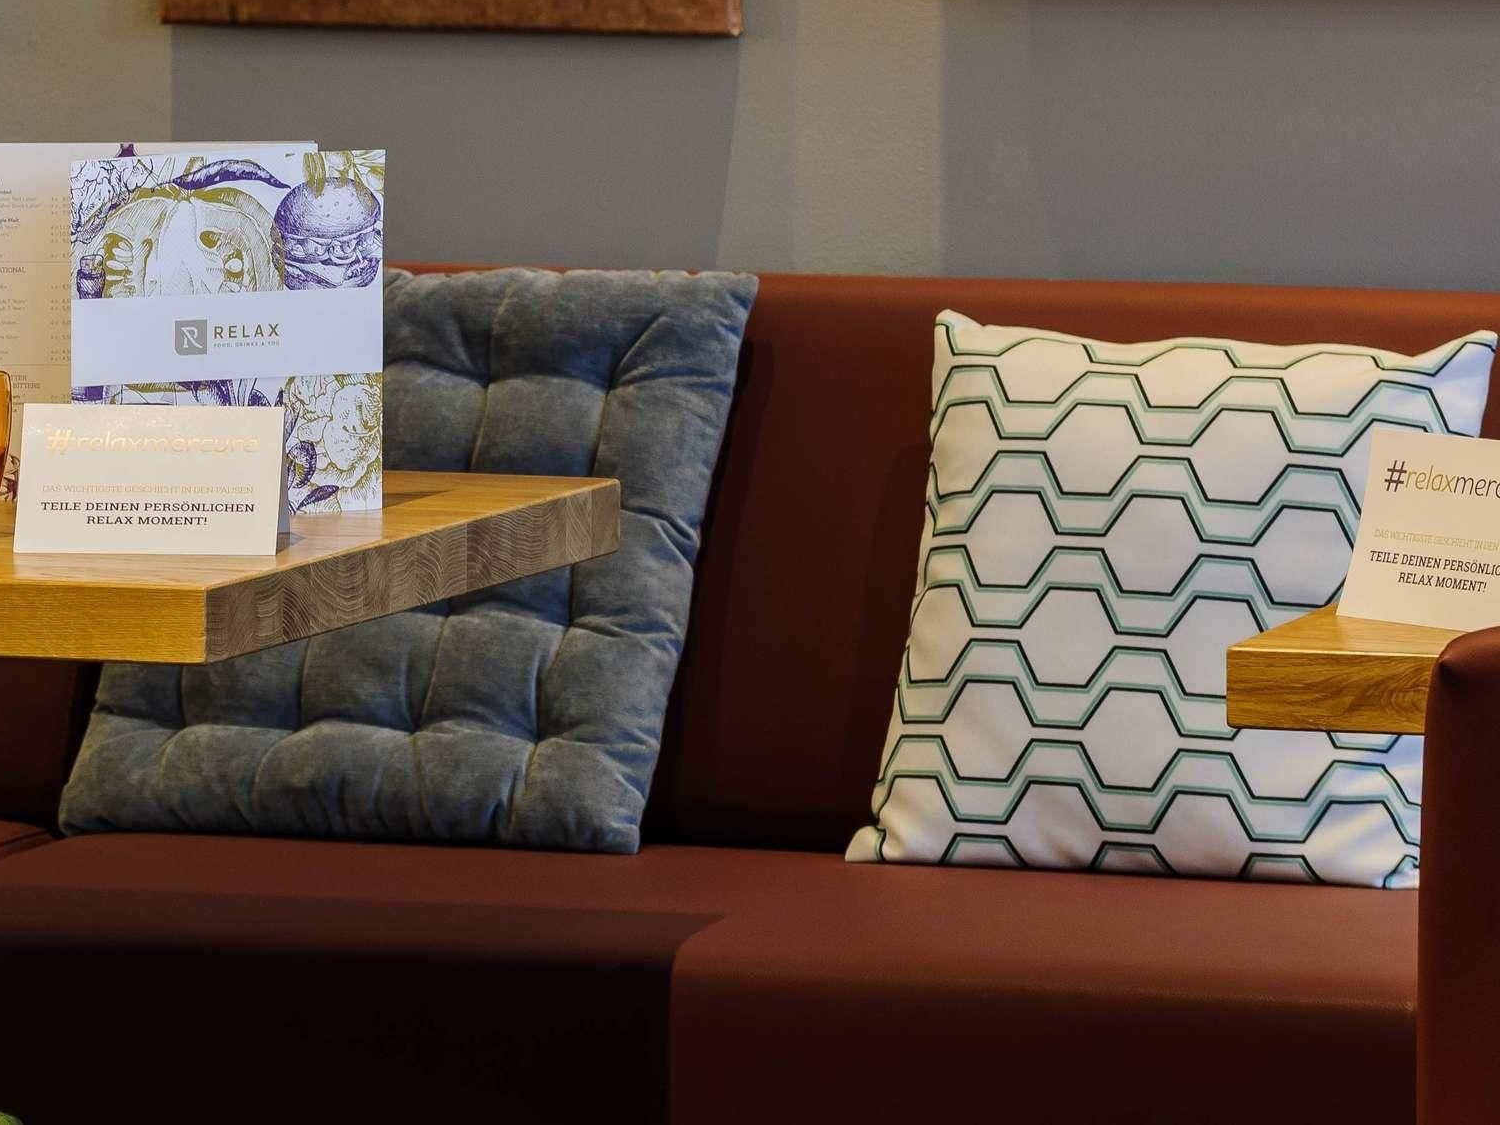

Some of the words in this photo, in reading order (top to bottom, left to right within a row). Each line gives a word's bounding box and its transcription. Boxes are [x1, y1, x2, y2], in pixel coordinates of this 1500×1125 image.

[214, 323, 279, 340] RELAX
[41, 501, 82, 511] TEILE
[85, 502, 140, 512] DEINEN
[144, 500, 255, 512] PERSÖNLICHEN
[86, 516, 133, 525] RELAX
[138, 516, 208, 526] MOMENT!
[1370, 550, 1400, 565] TEILE
[1400, 554, 1441, 569] DEINEN
[1398, 572, 1434, 586] RELAX
[1435, 577, 1488, 593] MOMENT!
